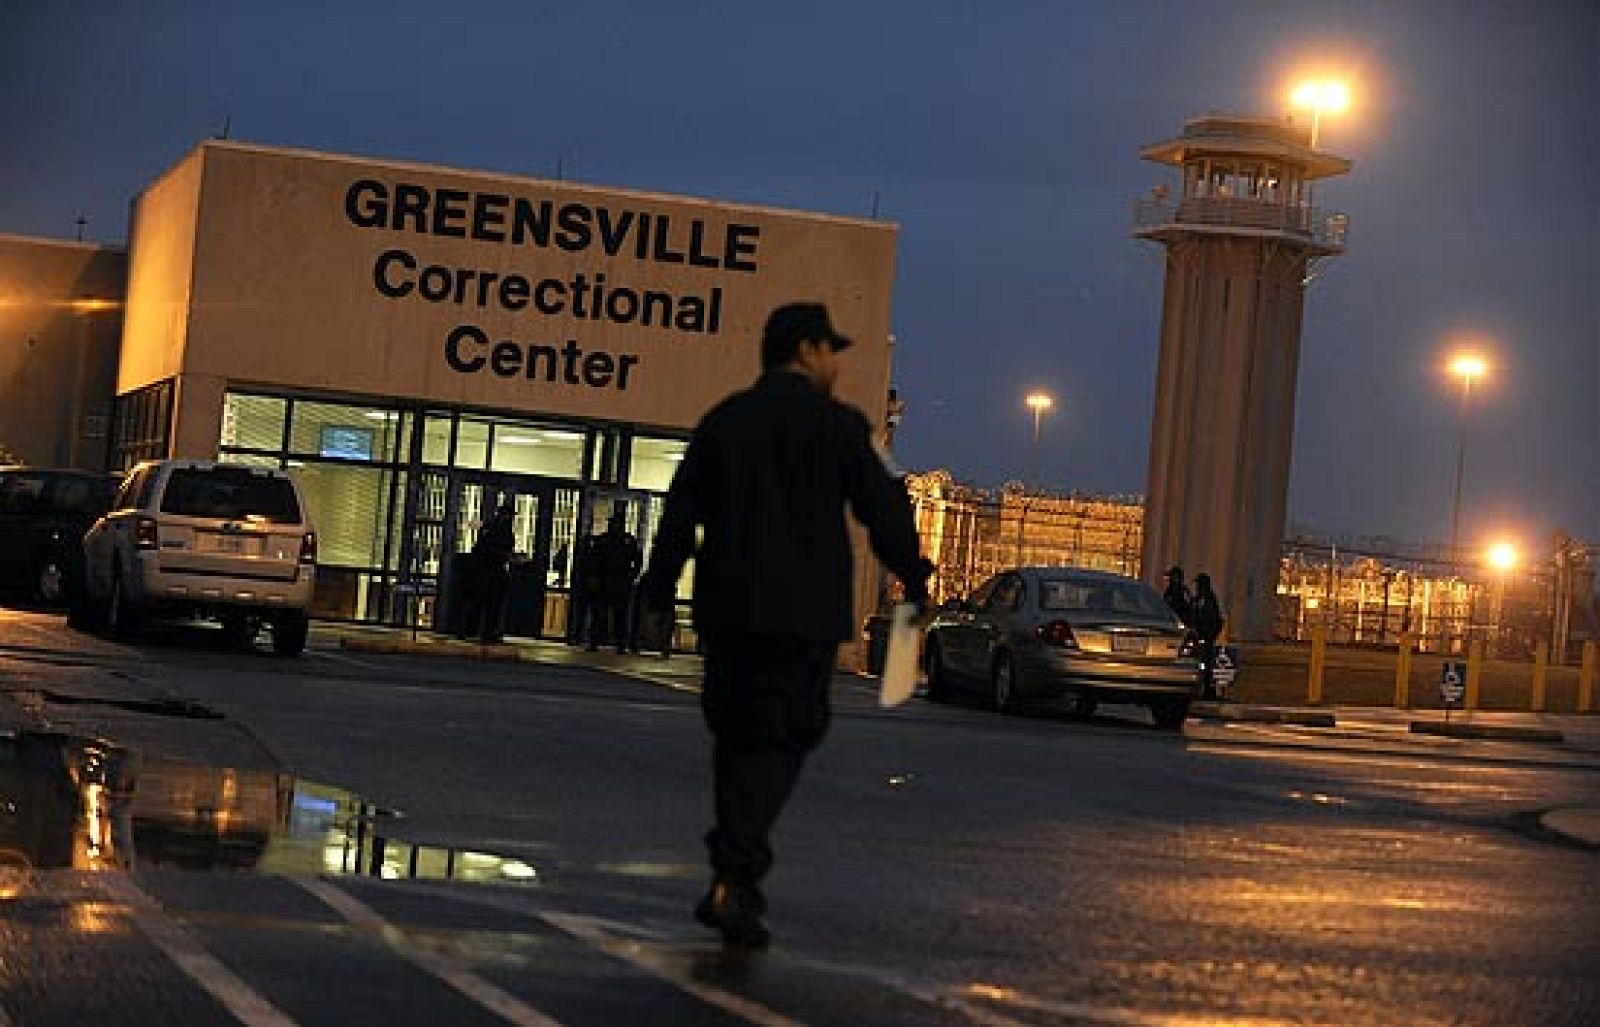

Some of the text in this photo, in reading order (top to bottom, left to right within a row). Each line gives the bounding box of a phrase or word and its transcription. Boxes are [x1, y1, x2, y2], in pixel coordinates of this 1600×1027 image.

[345, 179, 760, 272] GREENSVILLE
[372, 249, 722, 334] Correctional
[444, 325, 638, 391] Center
